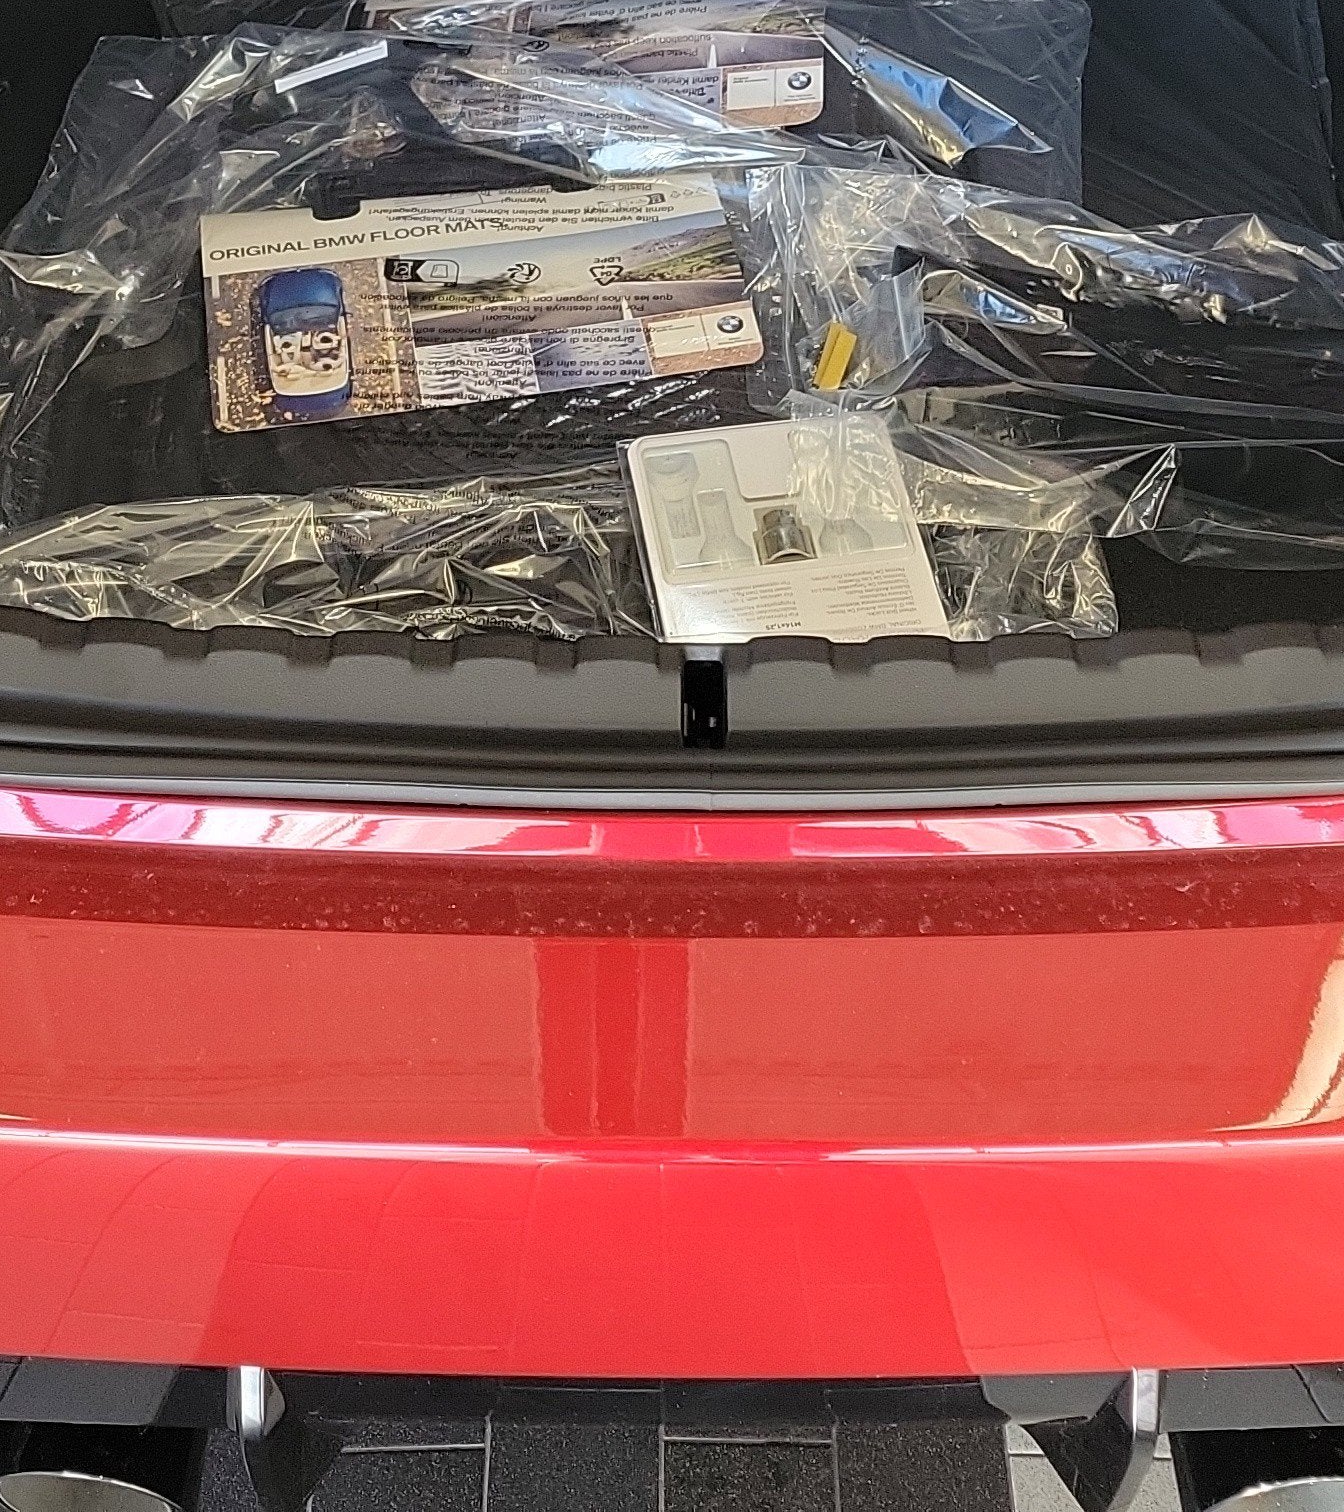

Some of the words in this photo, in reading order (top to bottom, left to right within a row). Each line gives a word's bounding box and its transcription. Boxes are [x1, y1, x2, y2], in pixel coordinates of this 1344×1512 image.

[618, 183, 652, 192] Plastic
[500, 196, 547, 205] Warning!
[581, 216, 633, 224] vernichten
[209, 241, 307, 261] ORIGINAL
[314, 234, 365, 249] BMW
[370, 224, 440, 242] FLOOR
[593, 256, 622, 264] LDPE
[533, 296, 553, 304] con
[556, 294, 599, 304] jueguen
[652, 294, 673, 302] que
[546, 304, 592, 313] destruya
[556, 361, 577, 369] afin
[562, 369, 582, 377] pas
[620, 369, 652, 377] Prière
